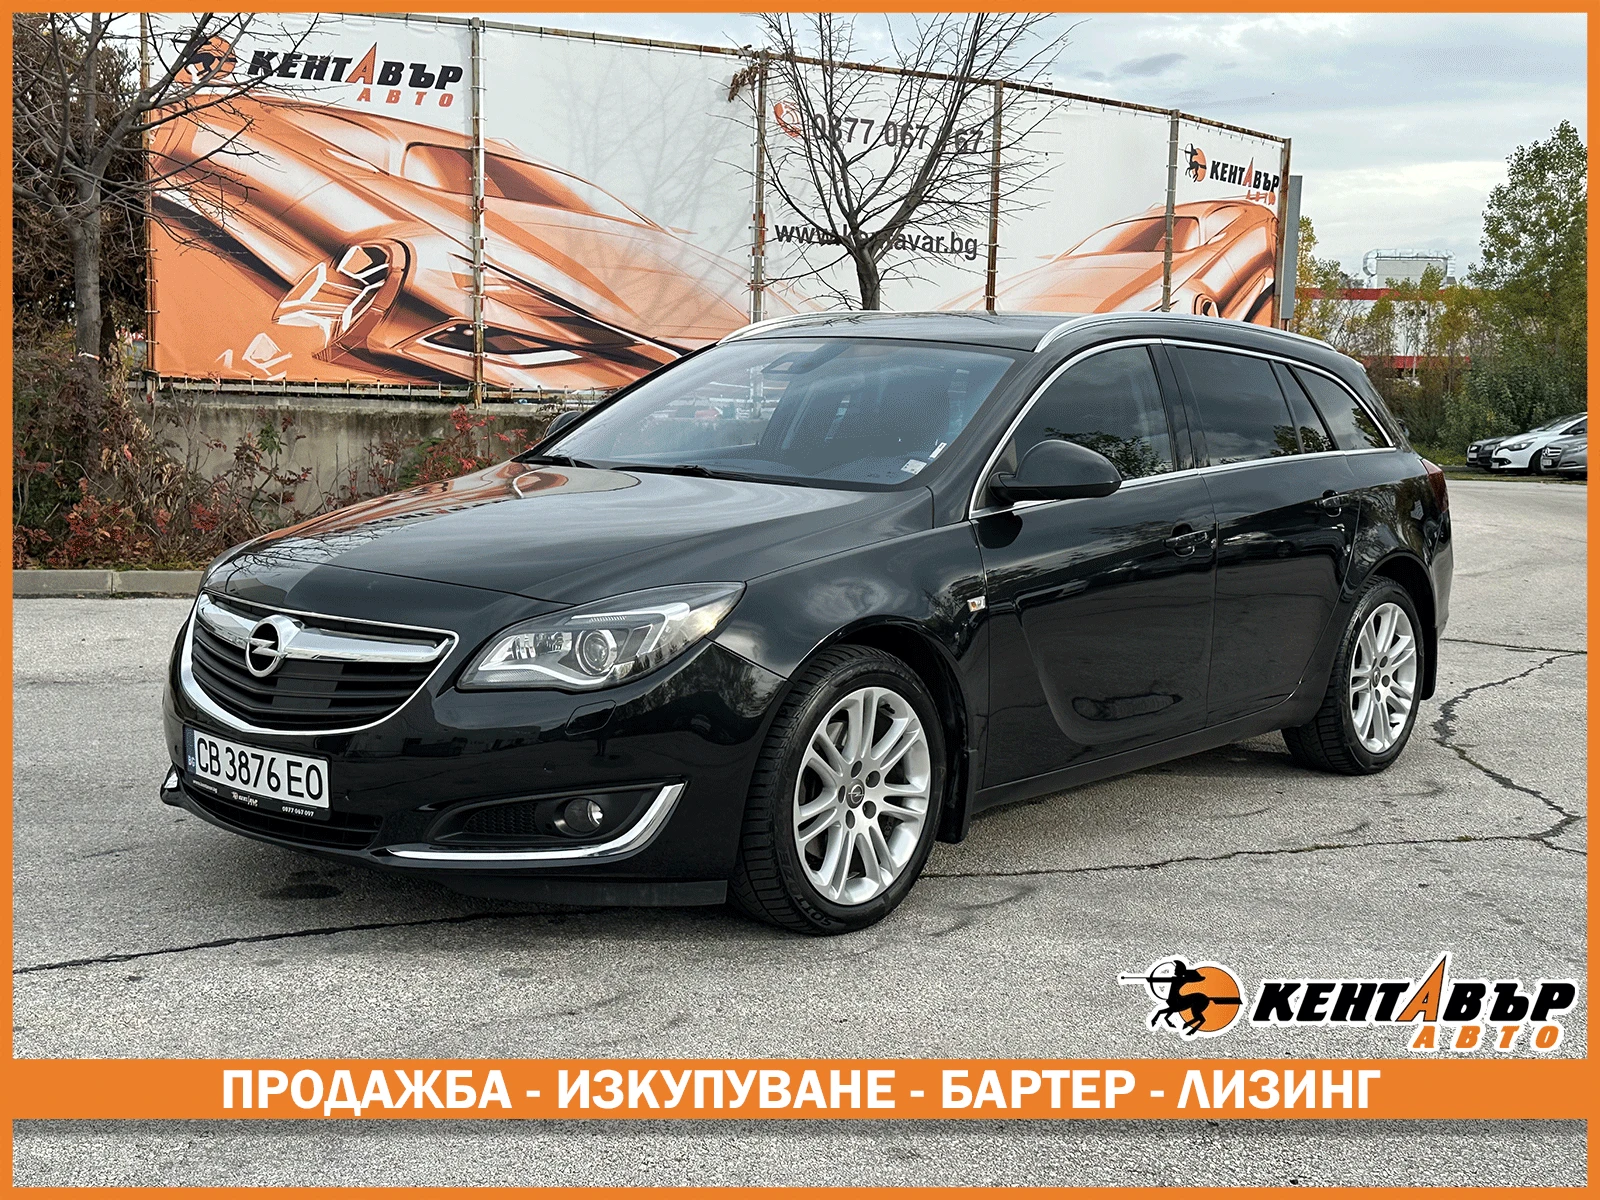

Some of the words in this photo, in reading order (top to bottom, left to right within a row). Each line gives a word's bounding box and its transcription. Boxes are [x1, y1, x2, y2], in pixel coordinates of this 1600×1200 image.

[247, 42, 463, 90] КЕНТАВЪР
[357, 88, 454, 108] АВТО
[811, 113, 875, 145] 0877
[884, 121, 930, 149] 067
[1209, 156, 1280, 192] КЕНТАВЪР
[225, 747, 281, 792] 3876
